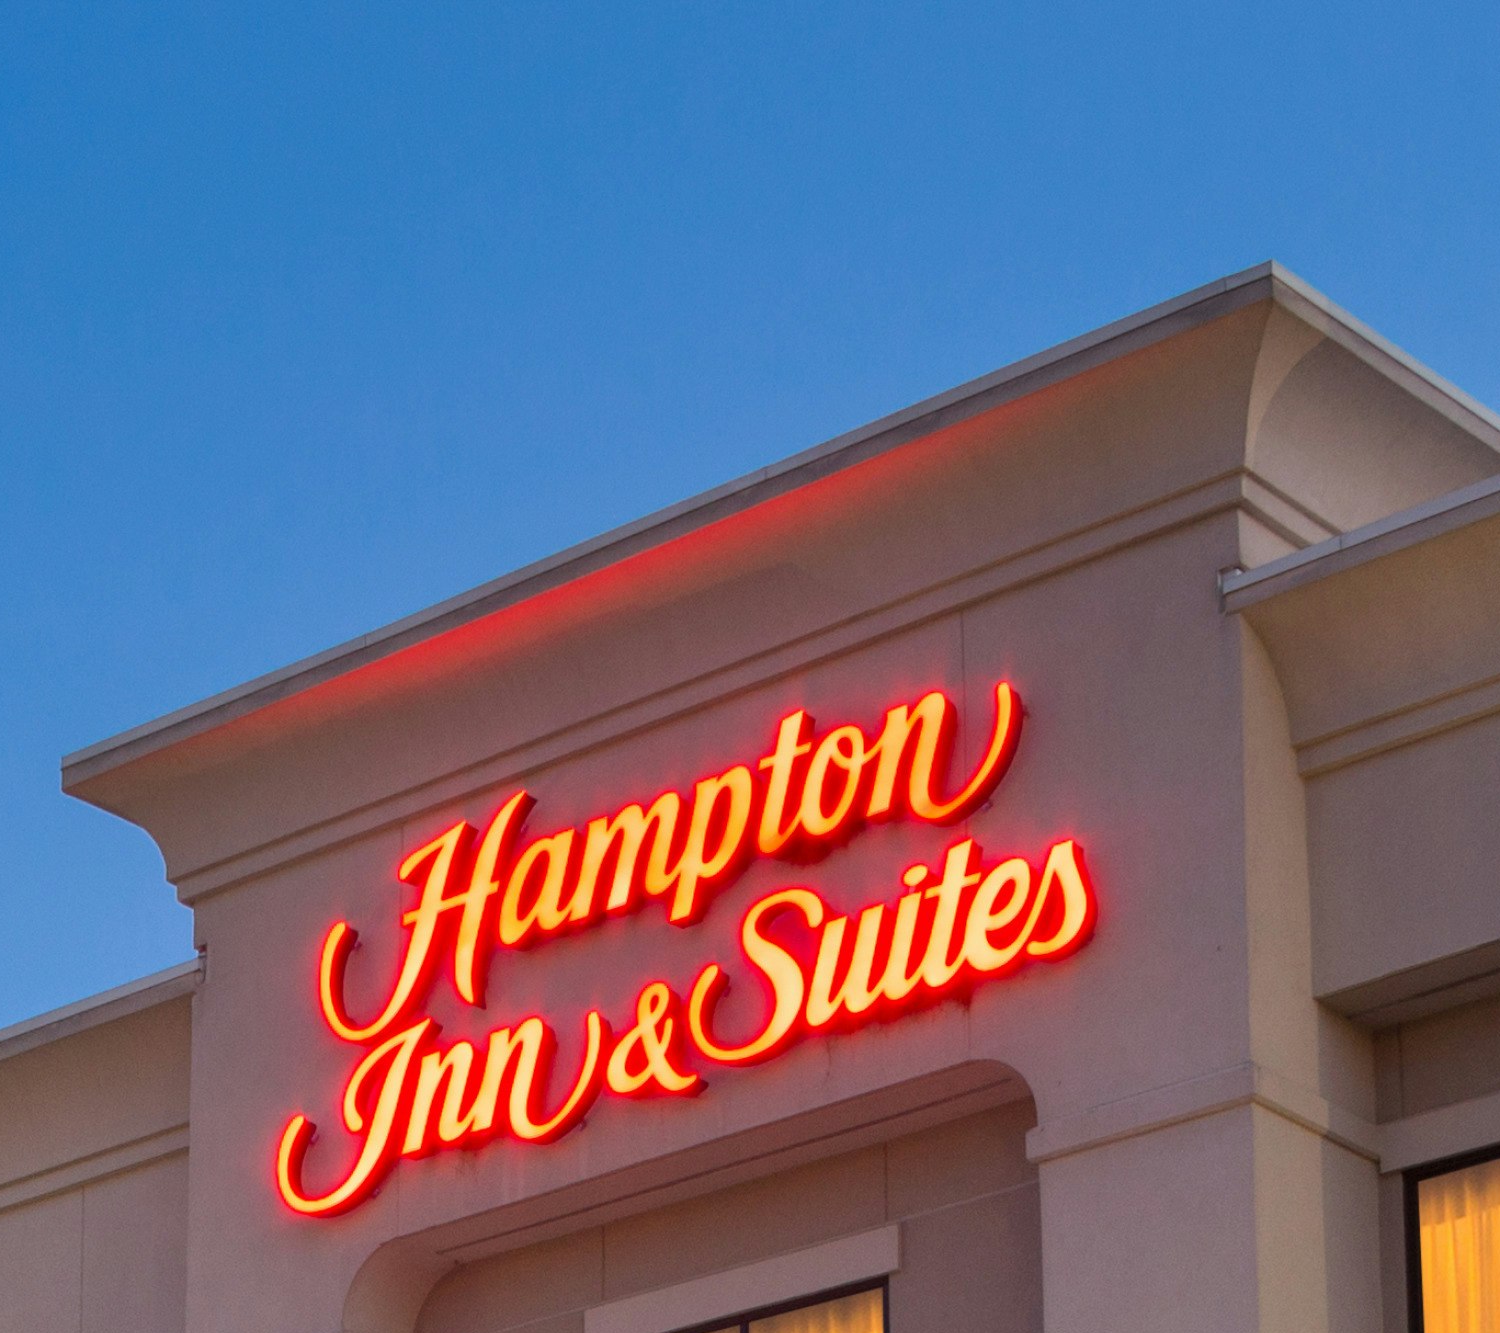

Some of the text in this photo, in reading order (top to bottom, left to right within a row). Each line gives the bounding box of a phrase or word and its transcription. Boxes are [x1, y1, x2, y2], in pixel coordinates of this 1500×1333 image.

[276, 838, 1096, 1216] Inn & Suites
[321, 680, 1023, 1041] Hampton
